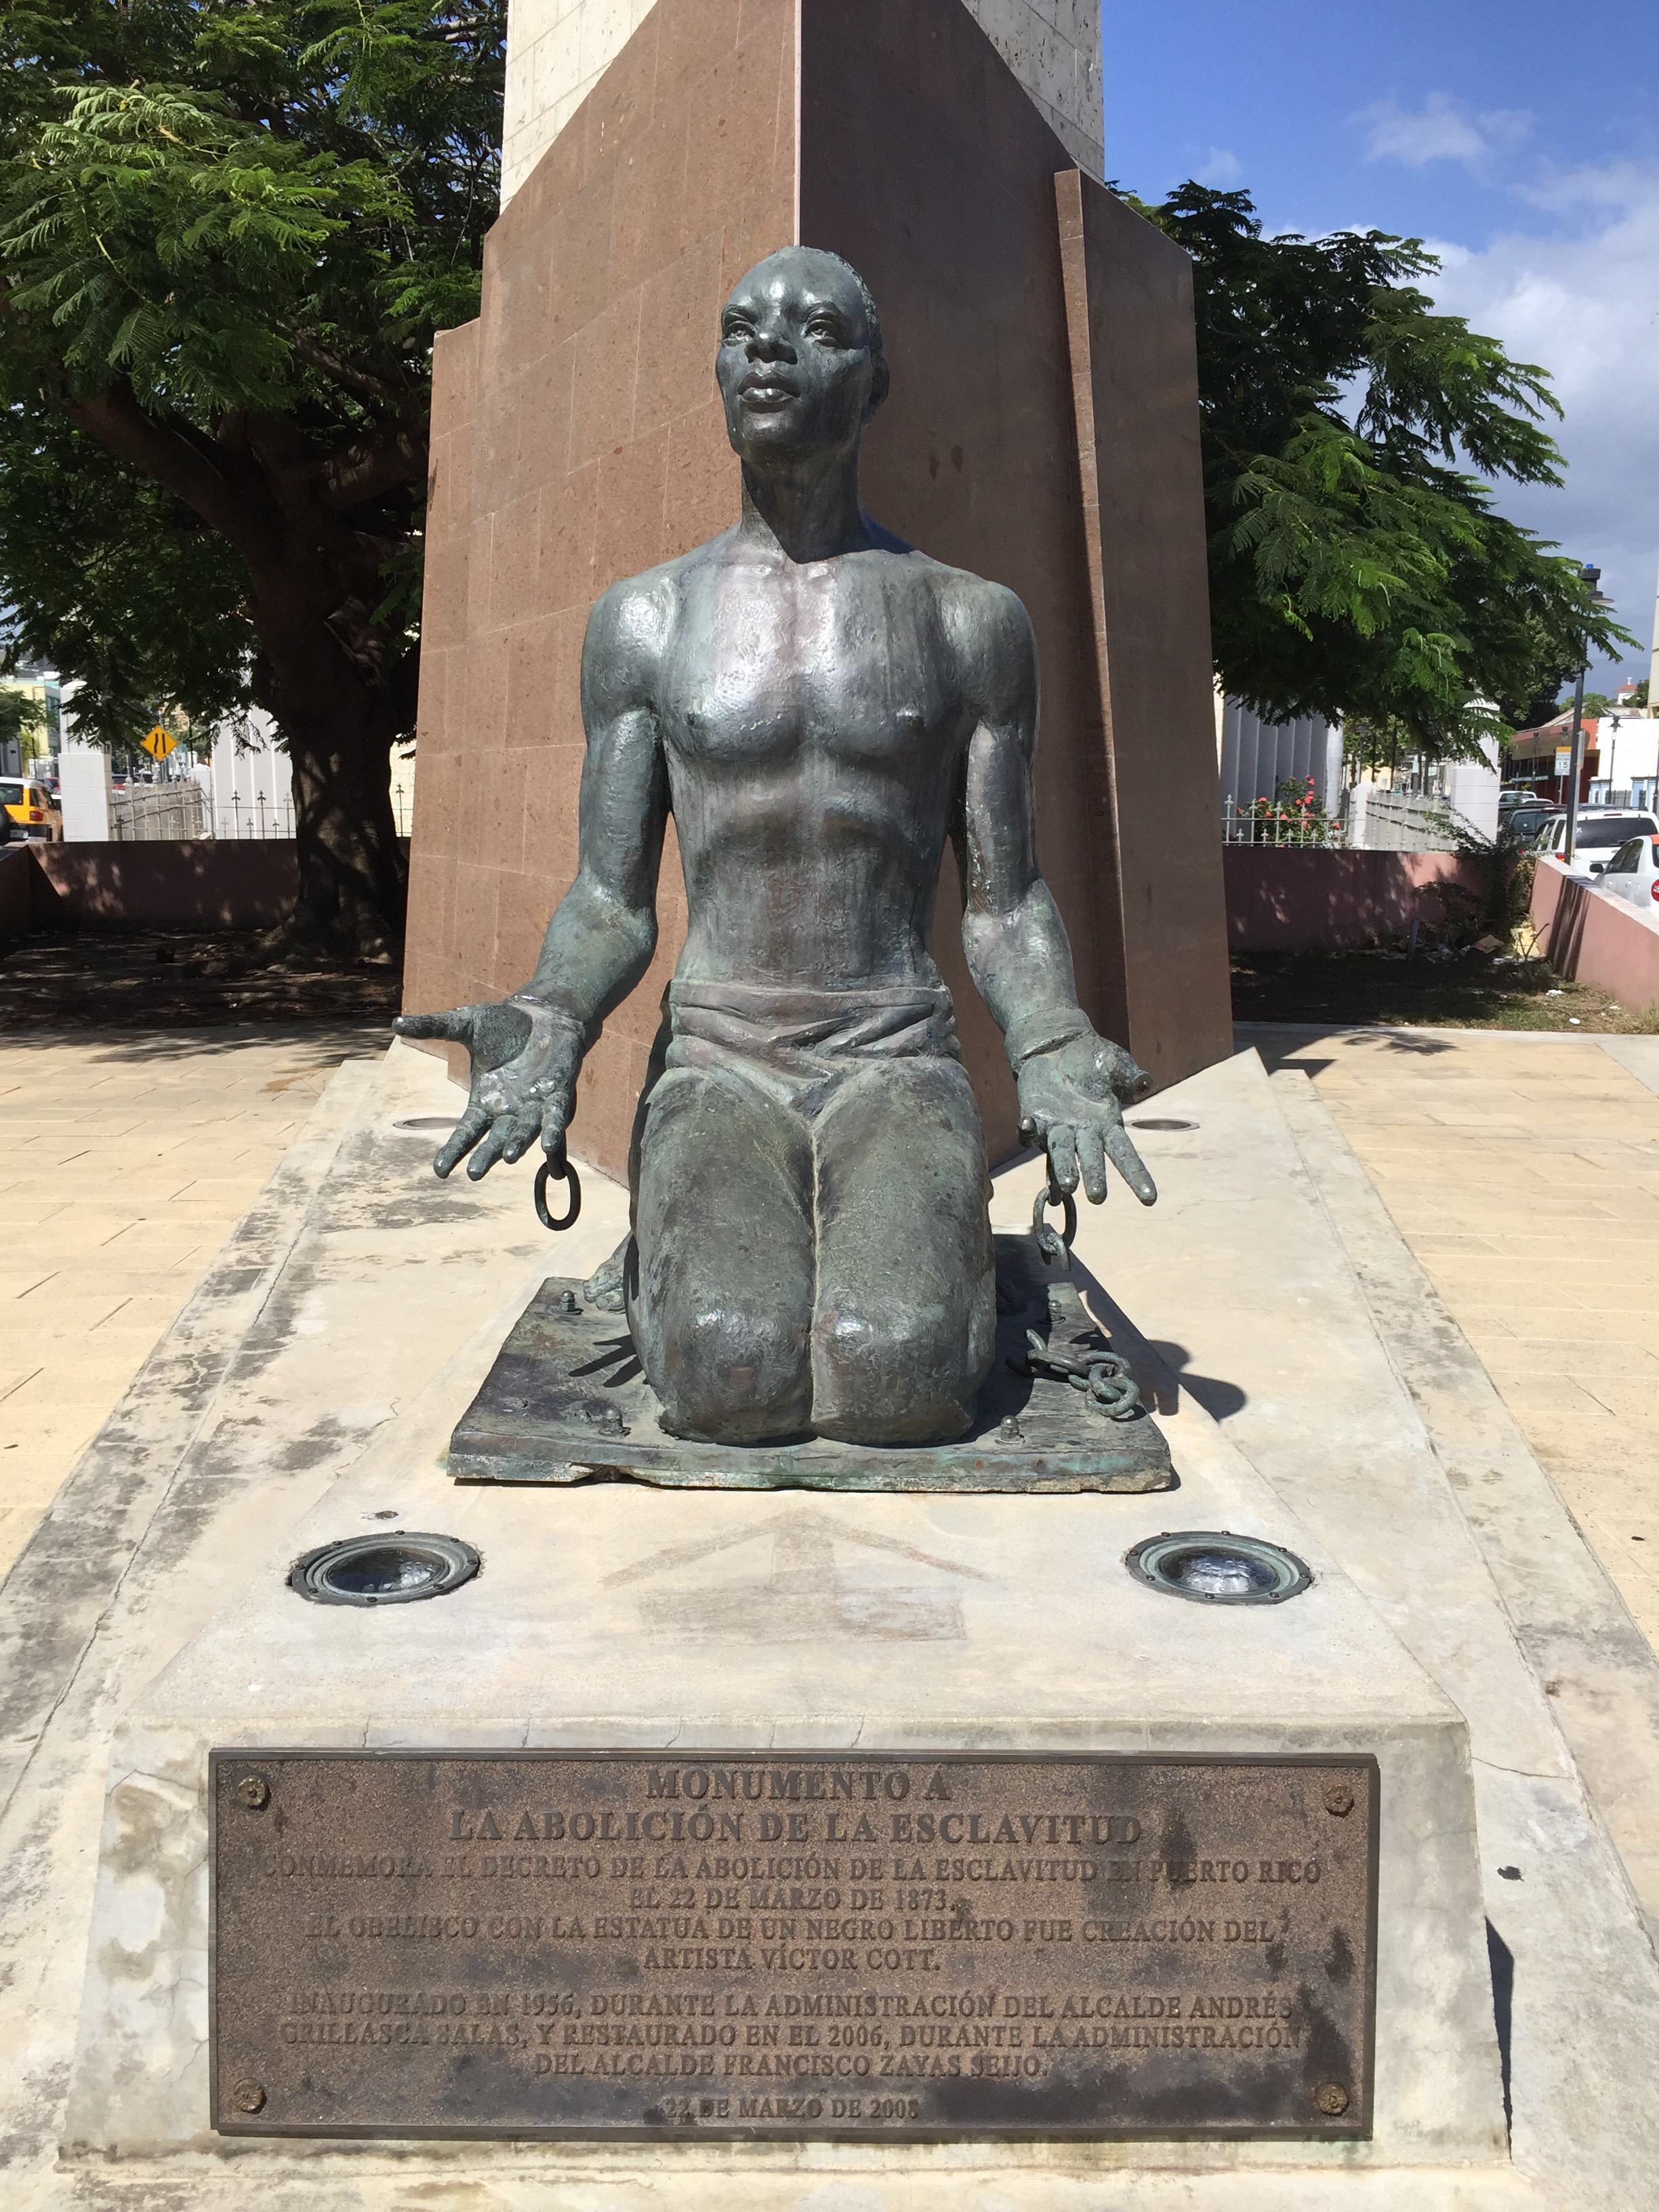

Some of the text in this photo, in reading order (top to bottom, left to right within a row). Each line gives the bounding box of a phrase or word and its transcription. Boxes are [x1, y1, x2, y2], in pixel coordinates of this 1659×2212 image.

[646, 1767, 951, 1800] MONUMENTO A
[449, 1803, 1141, 1845] LA ABOLICIÓN DE LA ESCLAVITUD
[262, 1852, 1321, 1883] CONMEMORA EL DECRETO DE LA ABOLICIÓN DE LA ESCLAVITUD EN PUERTO RICO
[630, 1887, 956, 1910] EL 22 DE MARZO DE 1873.
[304, 1914, 1274, 1942] EL OBELISCO CON LA ESTATUA DE UN NEGRO LIBERTO FUE CREACIÓN DEL
[641, 1944, 940, 1970] ARTISTA VÍCTOR COTT.
[289, 1990, 1292, 2019] INAUGURADO EN 1956, DURANTE LA ADMINISTRACIÓN DEL ALCALDE ANDRÉS
[436, 2023, 527, 2048] SALAS,
[535, 2024, 554, 2045] Y
[562, 2024, 735, 2046] RESTAURADO
[746, 2025, 779, 2047] EN
[788, 2025, 820, 2047] EL
[828, 2025, 889, 2050] 2006,
[900, 2026, 1021, 2047] DURANTE
[1033, 2026, 1065, 2047] LA
[1072, 2021, 1300, 2049] ADMINISTRACIÓN
[535, 2053, 1048, 2077] DEL ALCALDE FRANCISCO ZAYAS SEIJO.
[664, 2098, 919, 2119] 22 DE MARZO DE 2008
